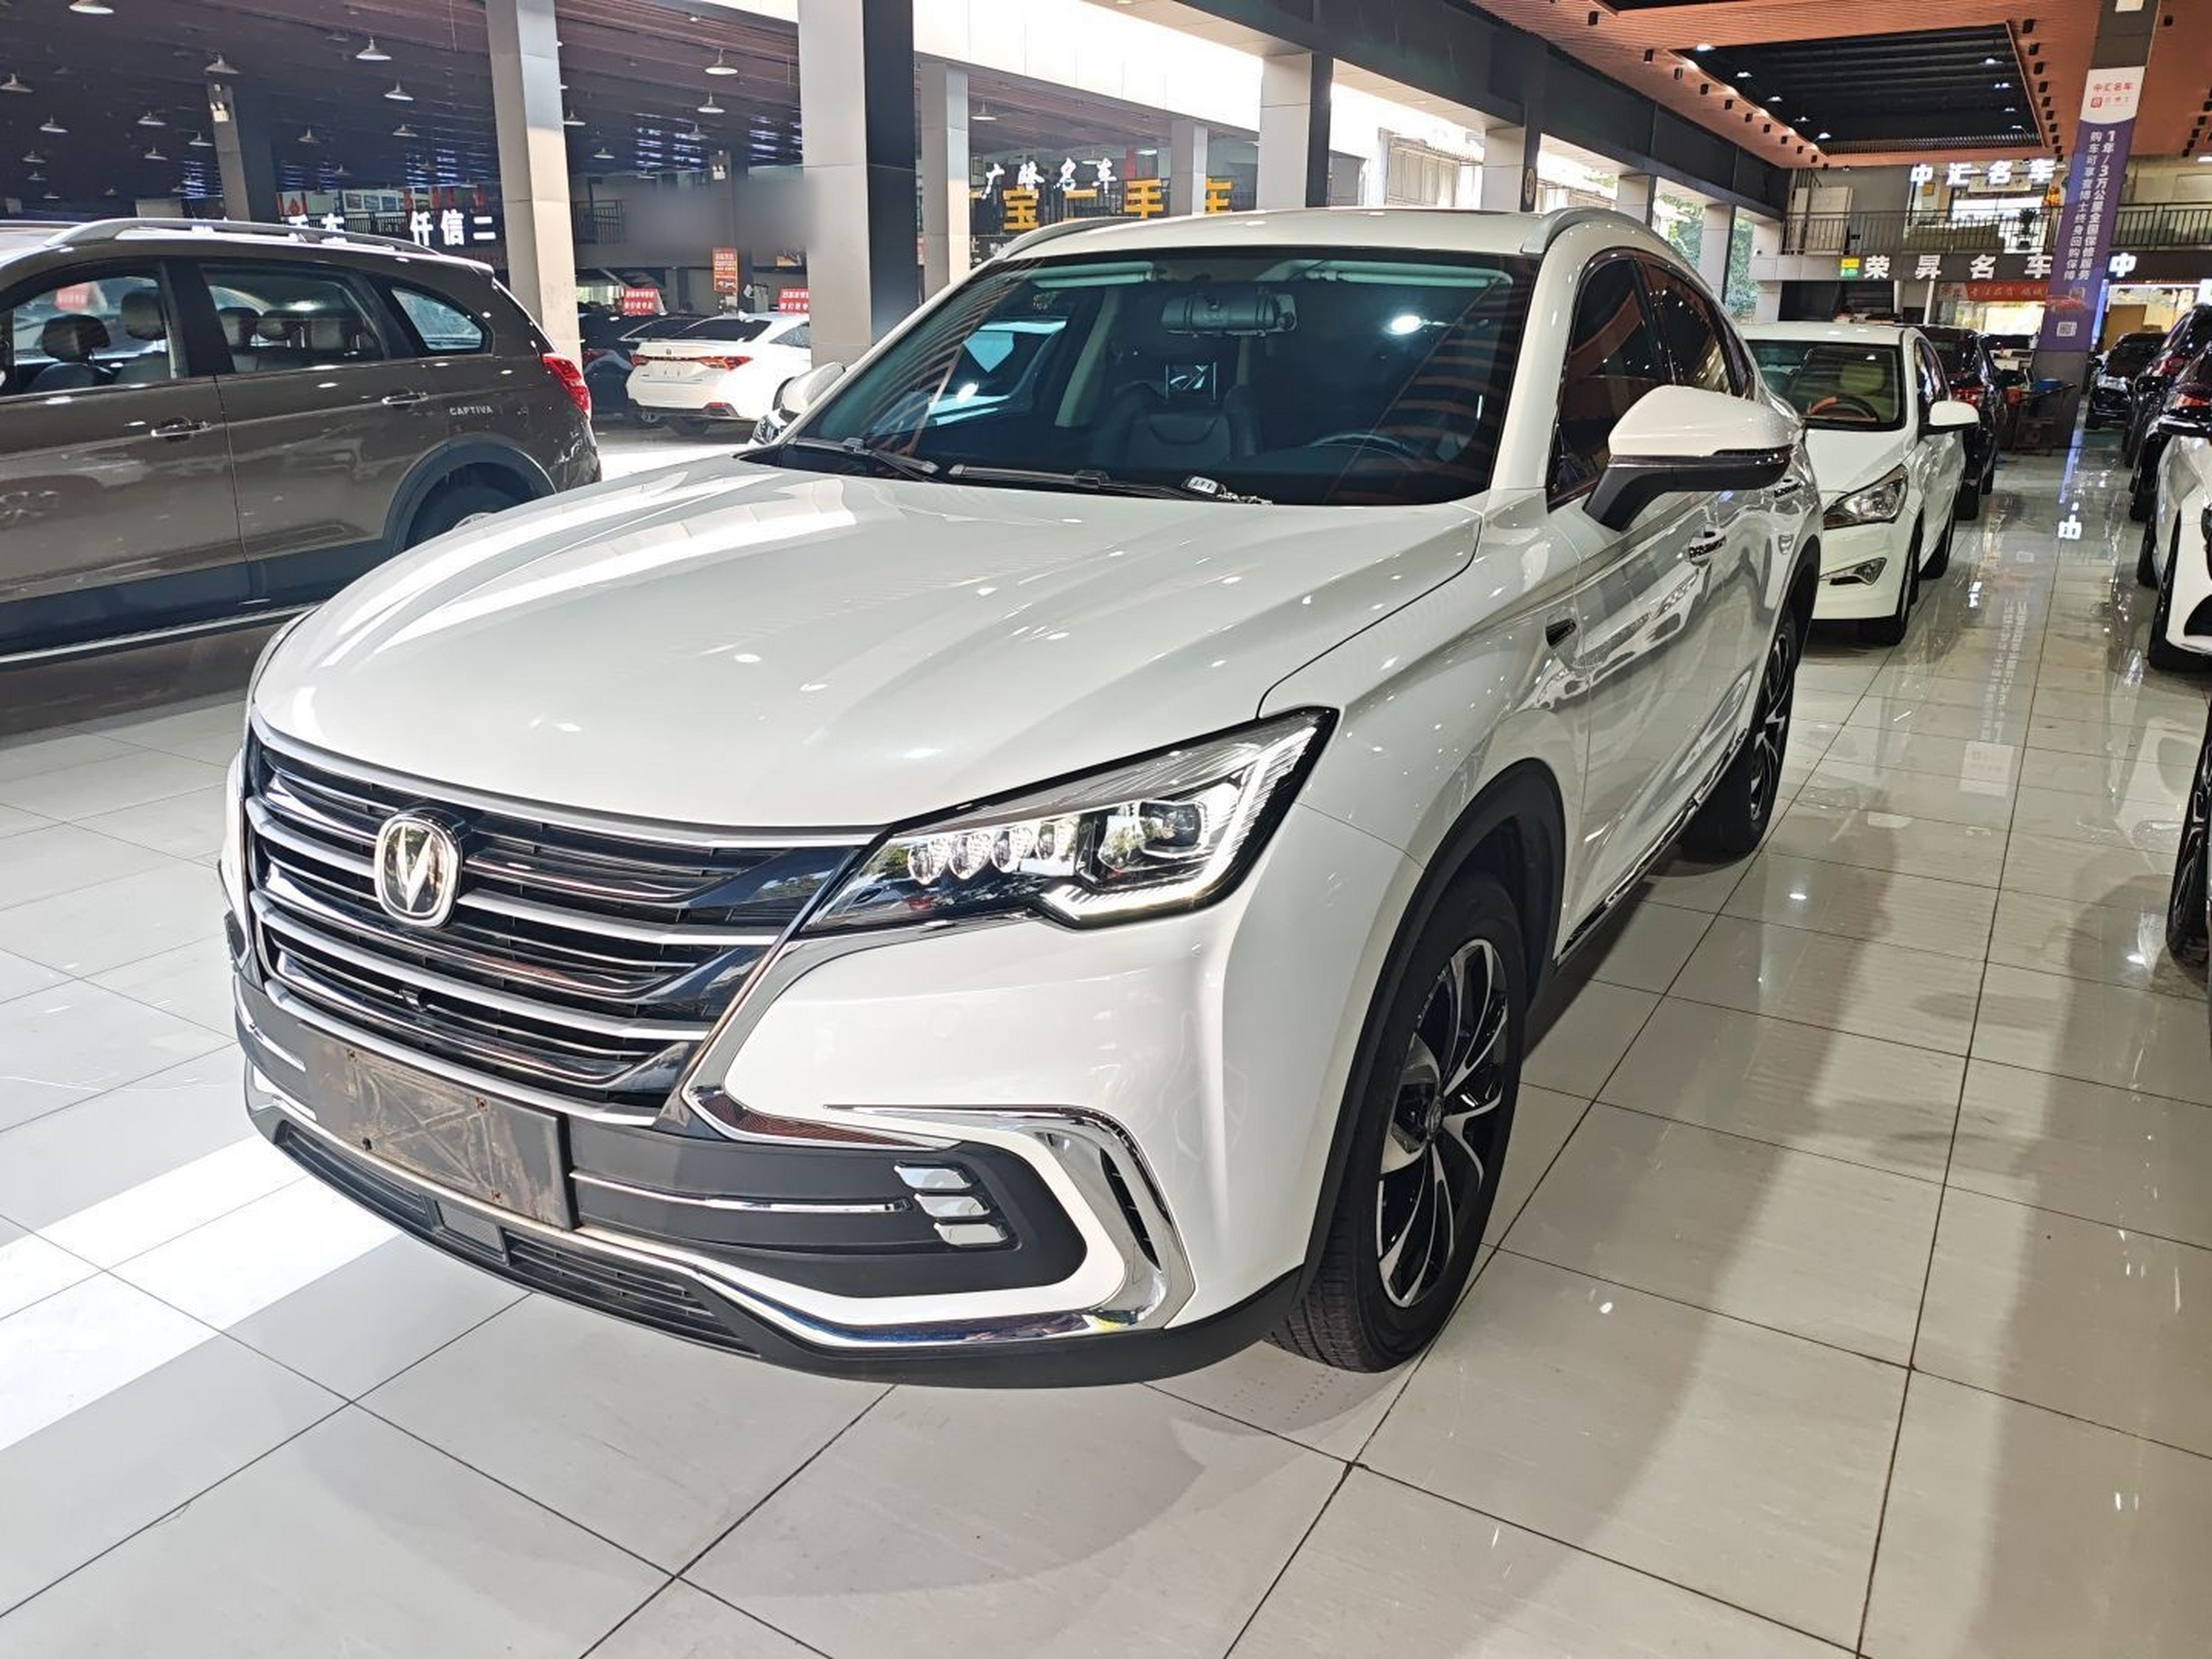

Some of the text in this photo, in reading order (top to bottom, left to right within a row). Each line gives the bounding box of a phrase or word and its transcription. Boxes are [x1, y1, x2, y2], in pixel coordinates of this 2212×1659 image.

[1910, 158, 2056, 187] 中汇名车
[2109, 252, 2137, 277] 中
[449, 405, 493, 415] CAPTIVA
